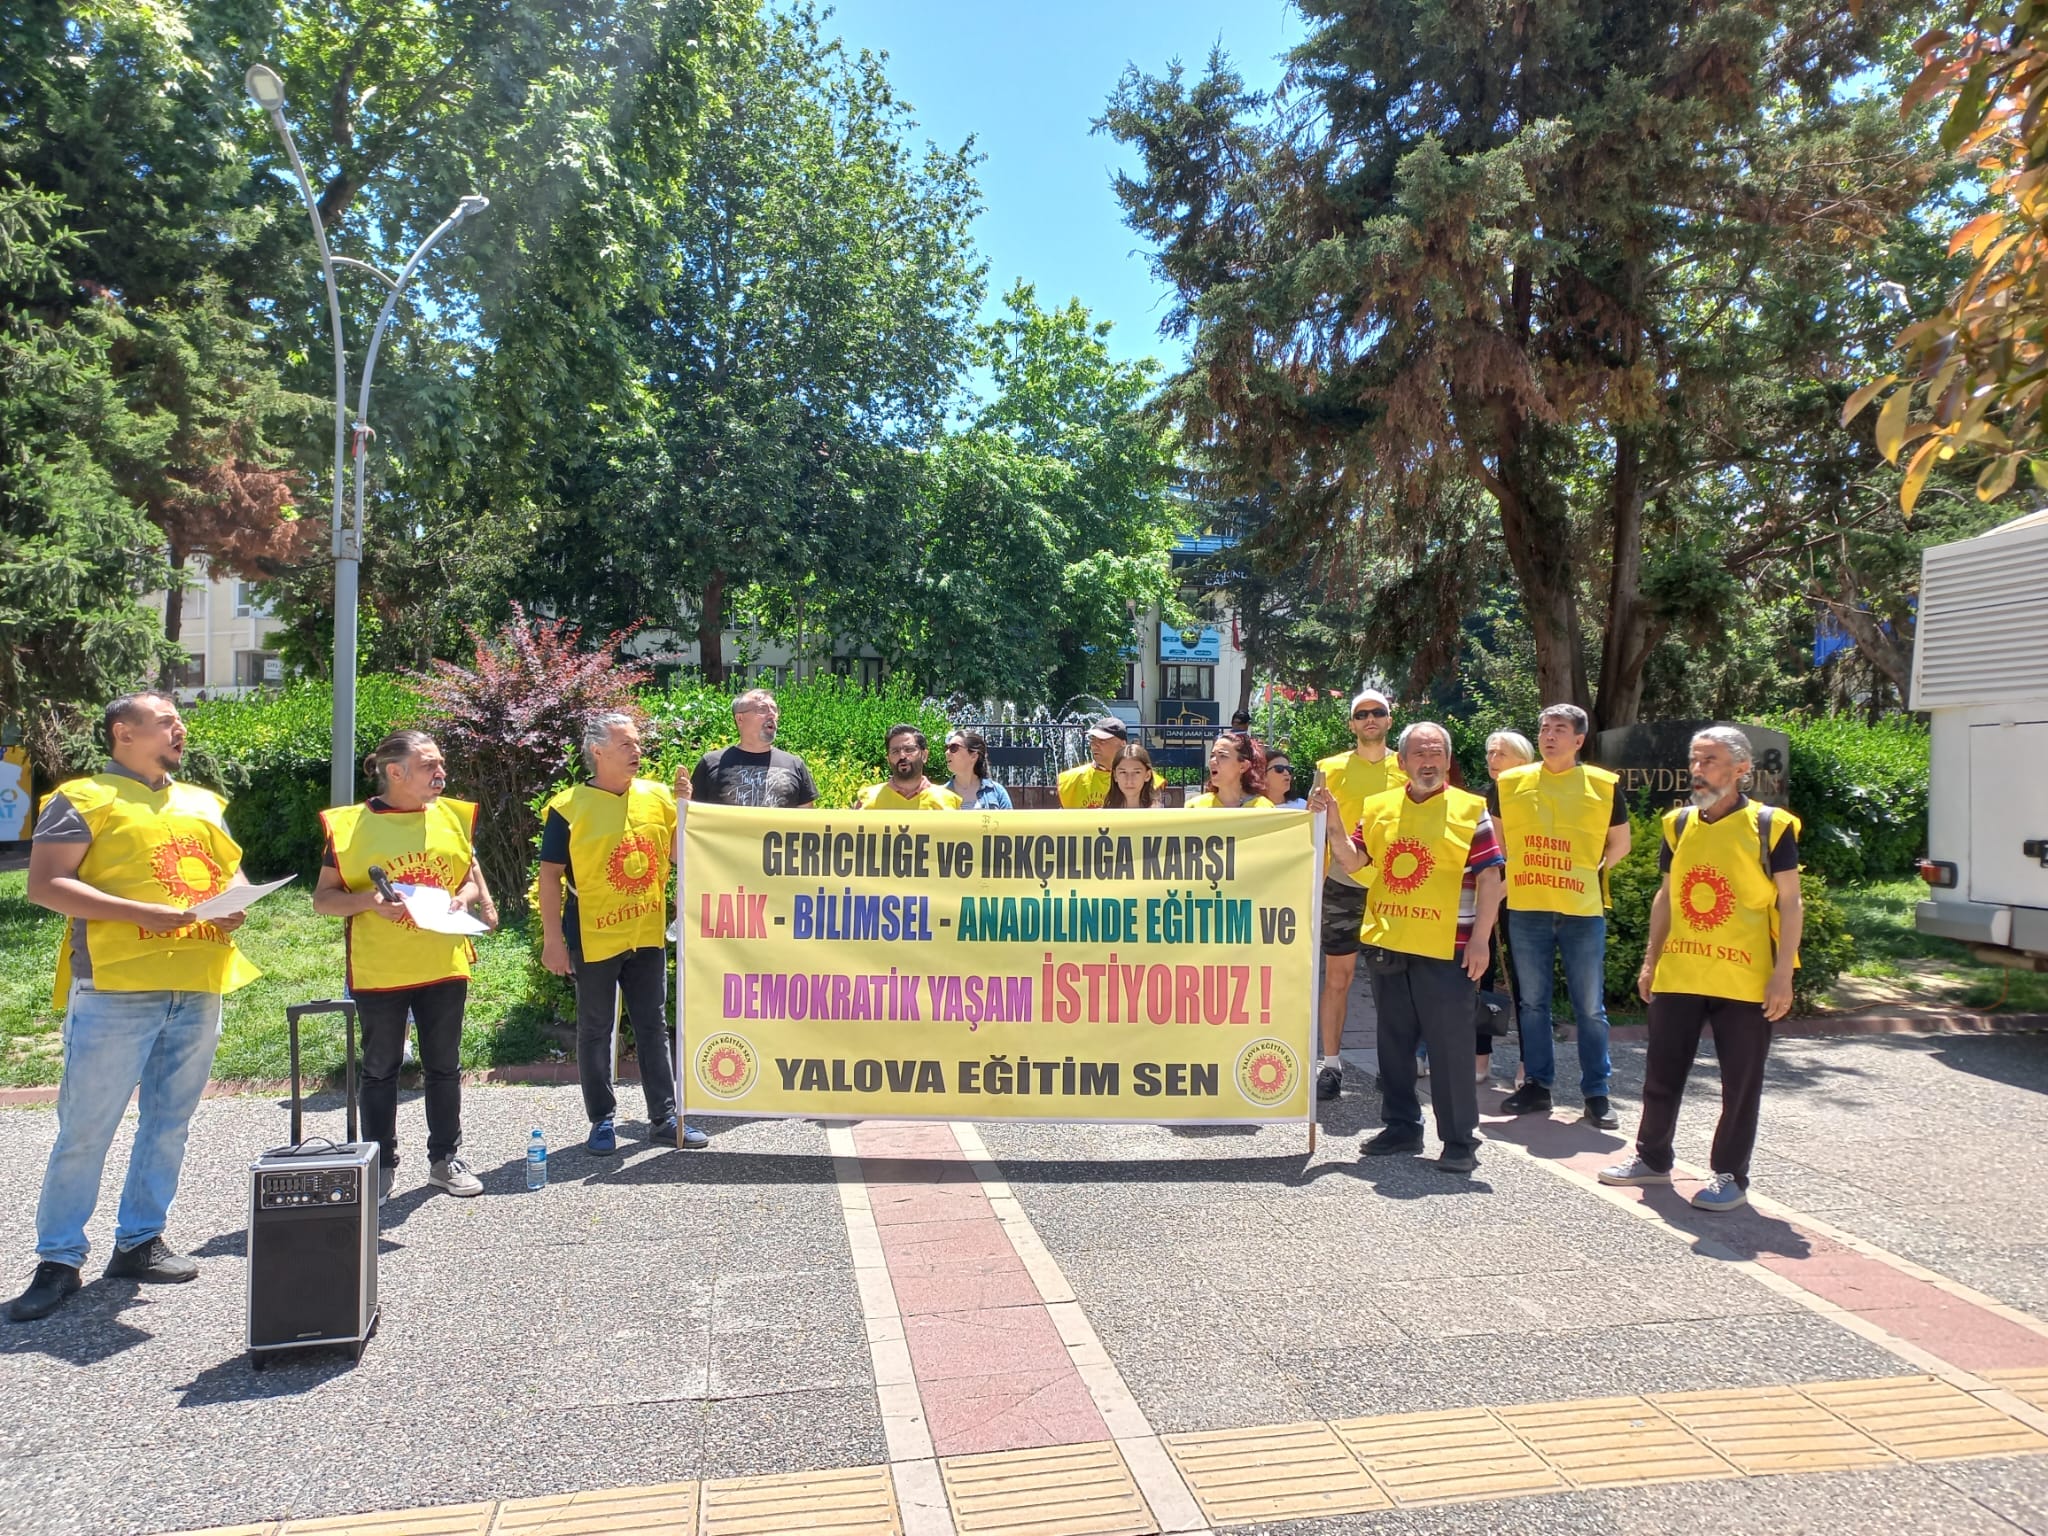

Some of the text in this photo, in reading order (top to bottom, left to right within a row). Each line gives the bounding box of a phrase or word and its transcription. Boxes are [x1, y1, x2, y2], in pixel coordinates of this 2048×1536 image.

[1614, 768, 1690, 793] CEVDE
[1524, 834, 1571, 853] YAŞASIN
[762, 825, 1236, 890] GERİCİLİĞE ve IRKÇILIĞA KARŞI
[1523, 851, 1573, 872] ÖRGÜTLÜ
[1514, 870, 1585, 895] MÜCADELEMİZ
[700, 885, 768, 939] LAİK
[793, 886, 933, 941] BİLİMSEL
[957, 888, 1139, 943] ANADİLİNDE
[1146, 888, 1252, 944] EĞİTİM
[1259, 906, 1296, 945] ve
[1411, 906, 1441, 921] SEN
[1716, 945, 1752, 965] SEN
[723, 967, 921, 1021] DEMOKRATİK
[927, 975, 1033, 1031] YAŞAM
[775, 1058, 946, 1093] YALOVA
[958, 1054, 1120, 1096] EĞİTİM
[1133, 1062, 1219, 1097] SEN
